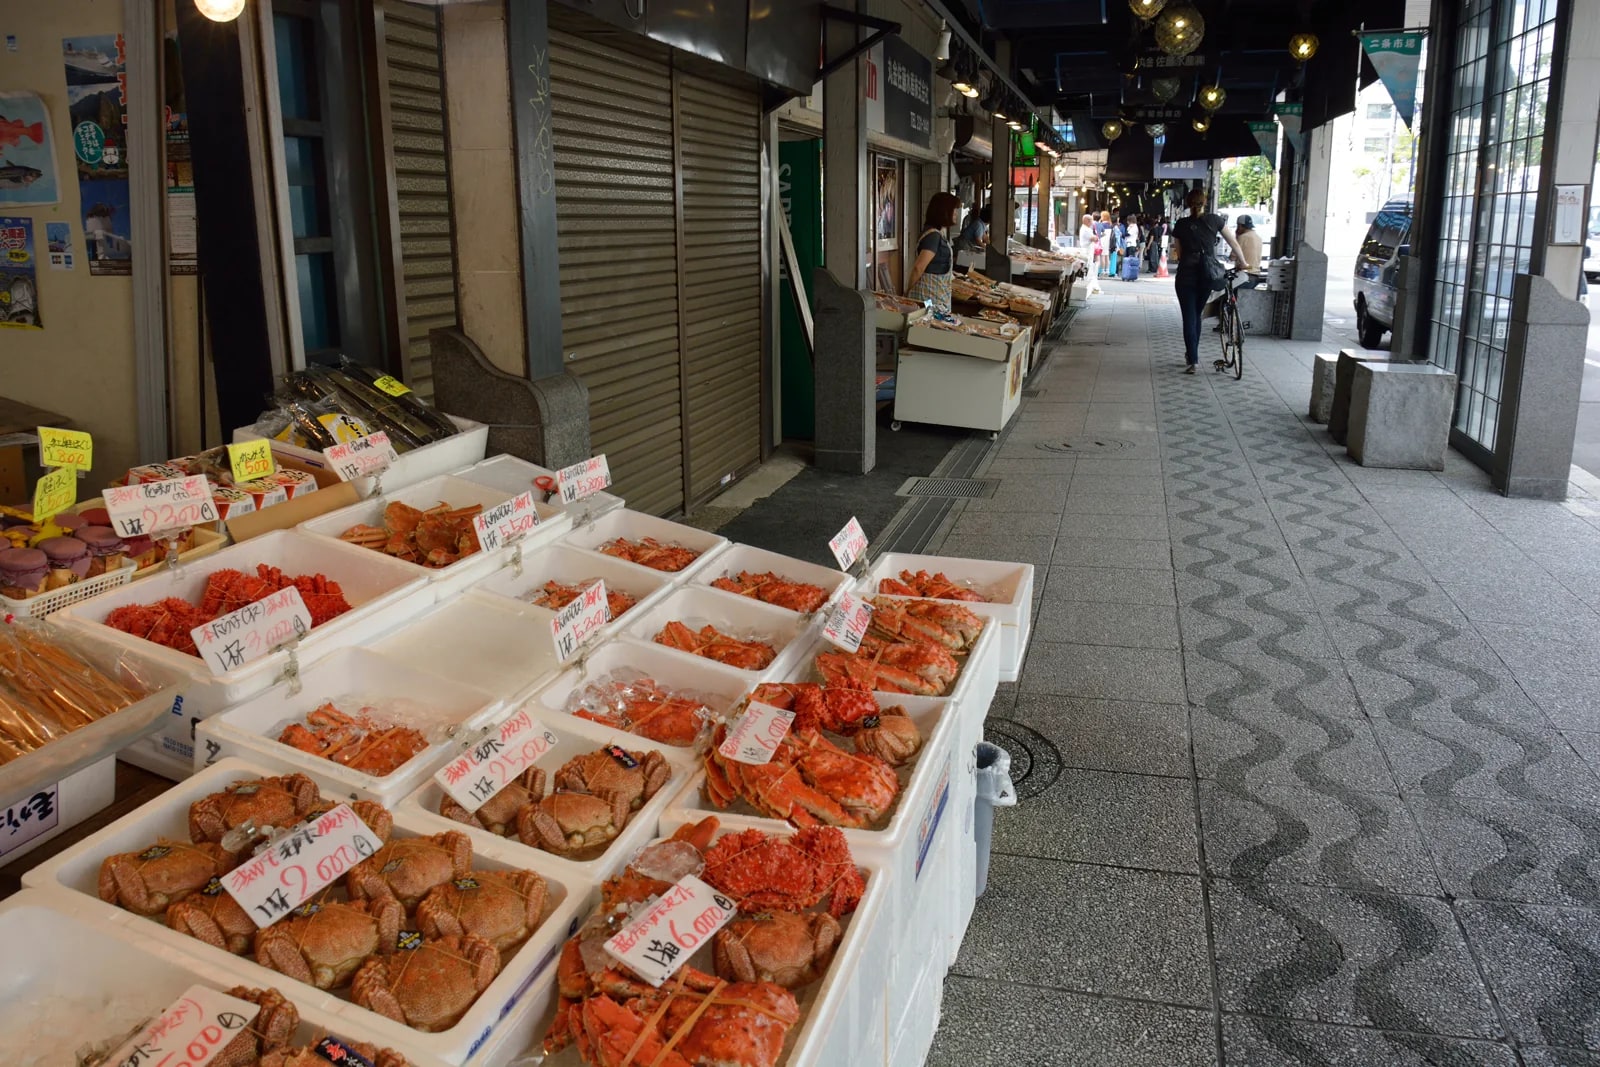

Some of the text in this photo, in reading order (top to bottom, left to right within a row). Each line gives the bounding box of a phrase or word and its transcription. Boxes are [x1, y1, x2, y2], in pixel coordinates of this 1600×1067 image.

[1369, 38, 1417, 49] 二条市場
[245, 459, 269, 475] 500
